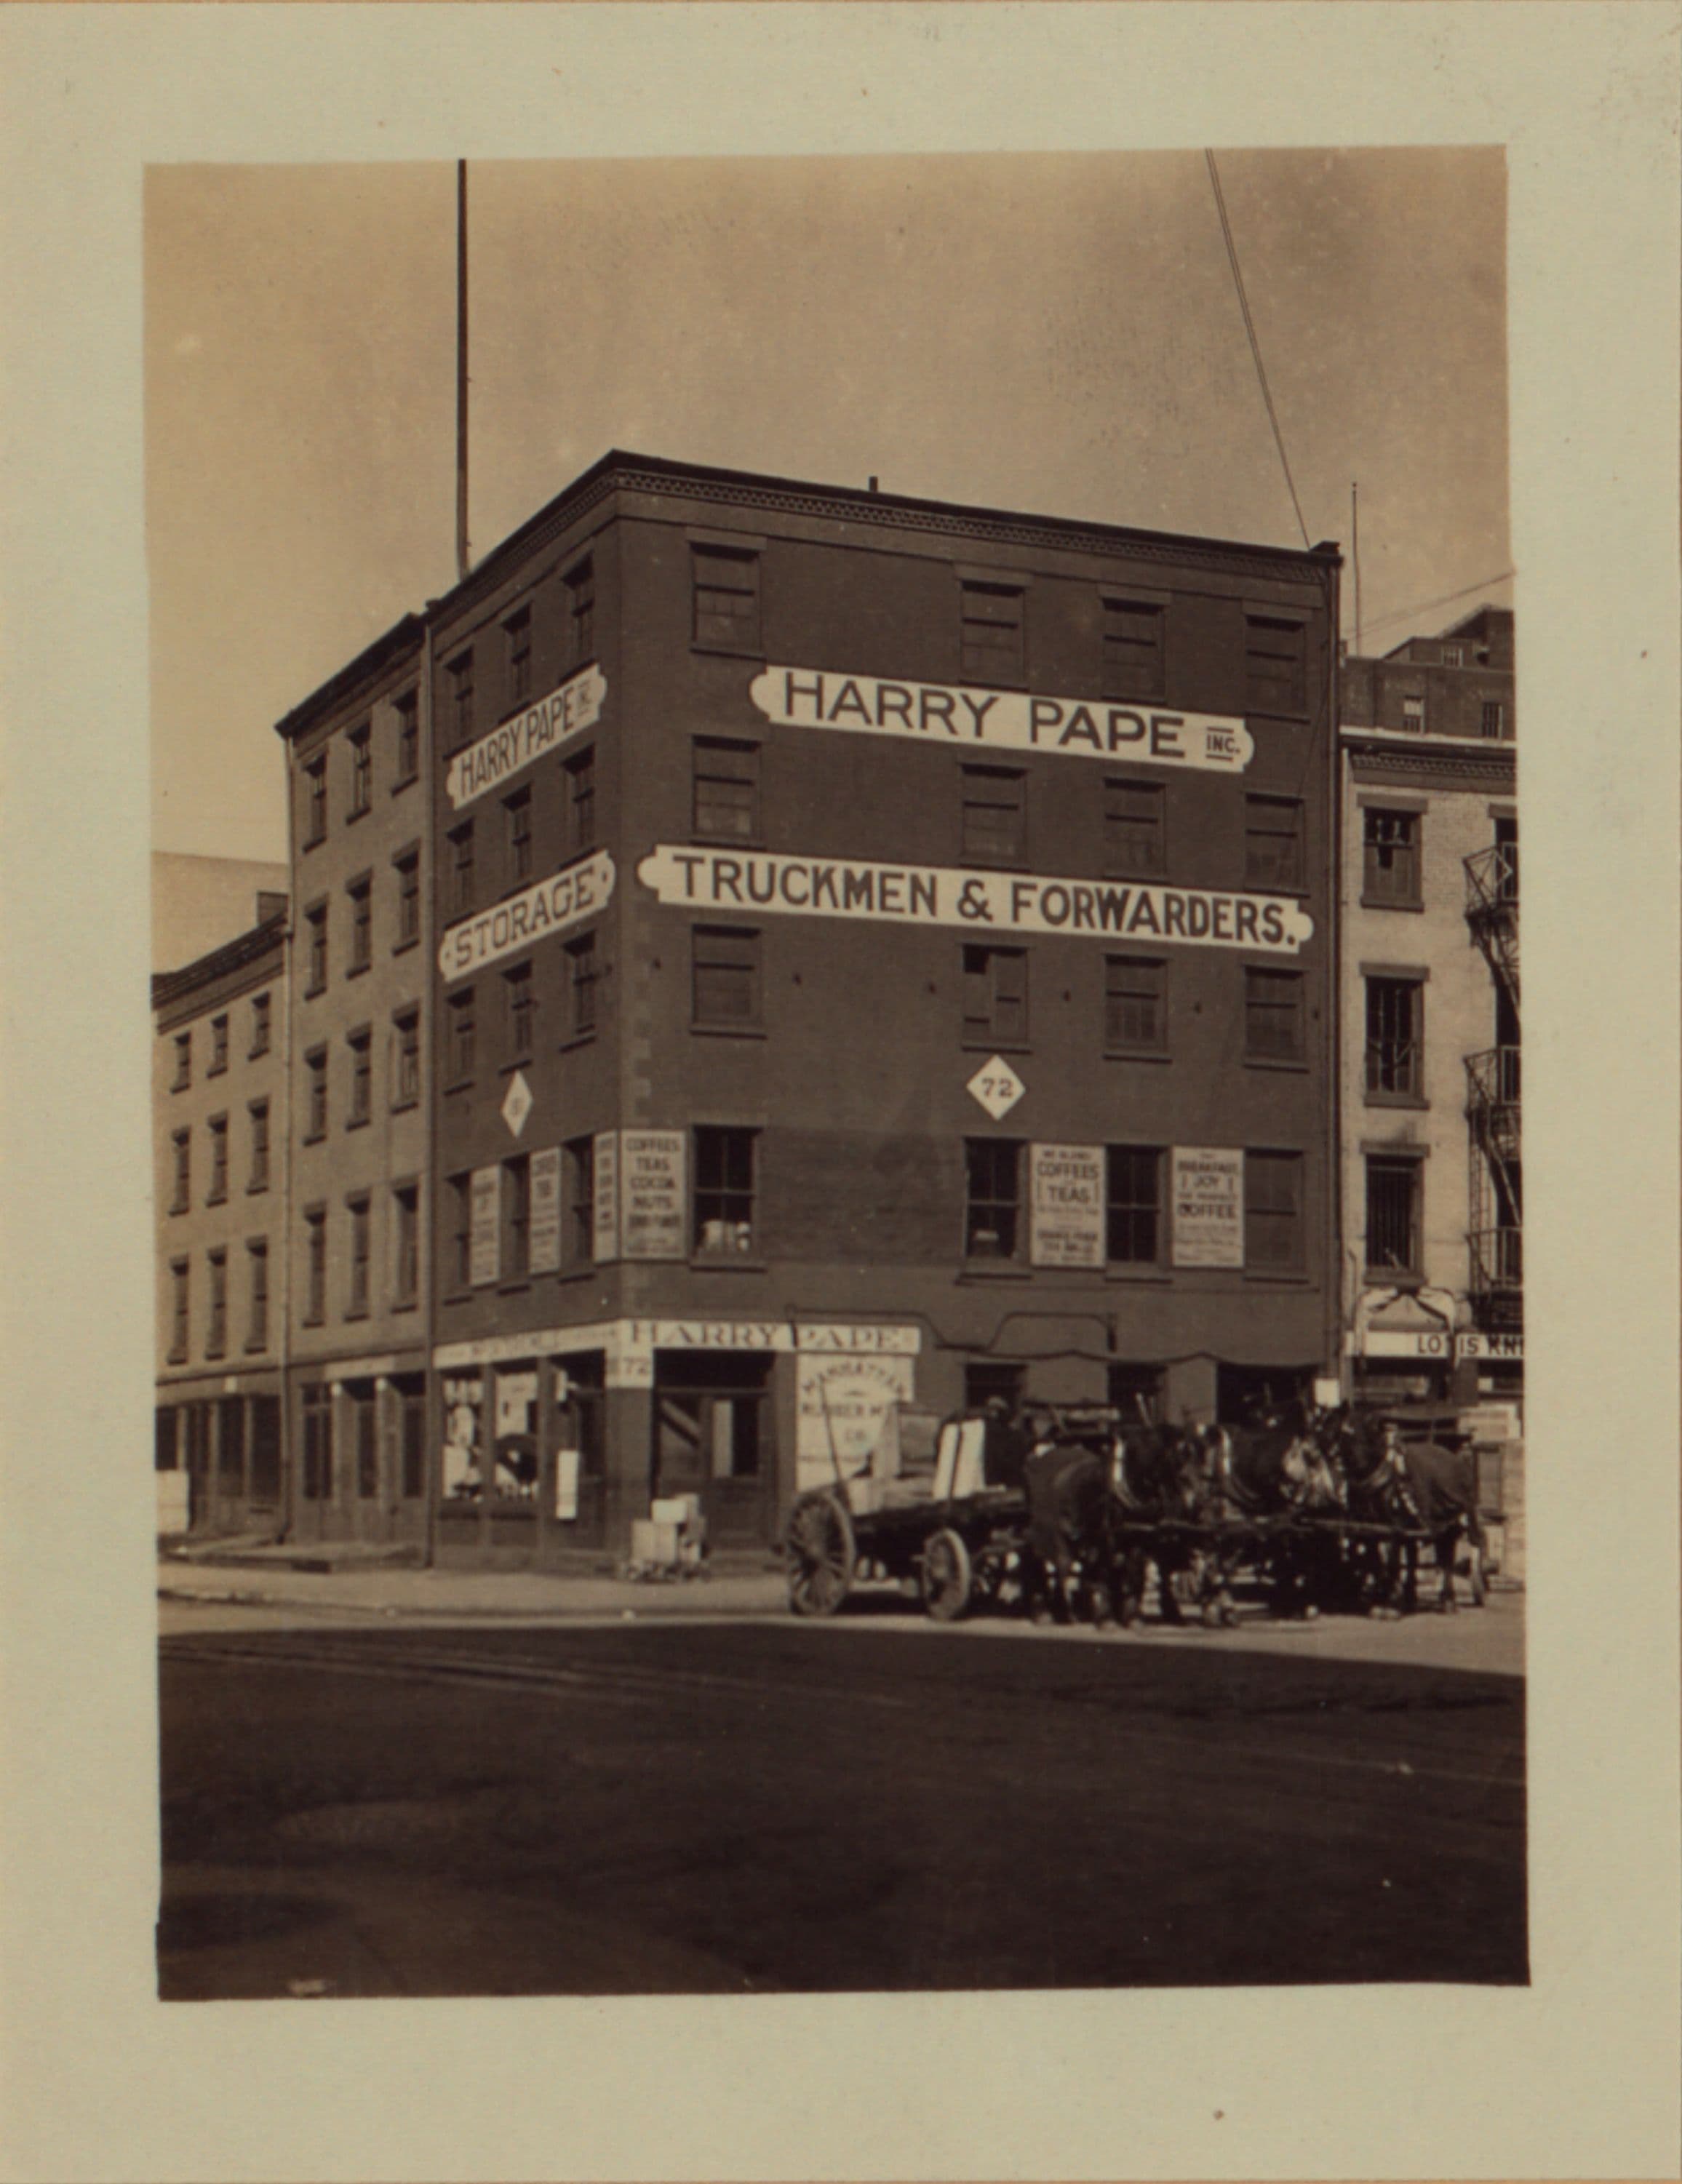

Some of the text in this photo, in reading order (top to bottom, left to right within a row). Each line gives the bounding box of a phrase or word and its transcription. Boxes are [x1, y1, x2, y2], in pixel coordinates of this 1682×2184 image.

[784, 671, 1241, 759] HARRY PAPE INC.
[459, 717, 524, 799] HARRY
[526, 686, 574, 754] PAPE
[672, 854, 1296, 946] TRUCKMEN & FORWARDERS.
[455, 866, 594, 968] STORAGE
[981, 1077, 1014, 1098] 72
[1037, 1160, 1099, 1180] COFFEES
[1048, 1184, 1091, 1204] TEAS
[1178, 1203, 1237, 1219] COFFEE
[630, 1320, 778, 1346] HARRY
[1418, 1336, 1479, 1355] LOIS
